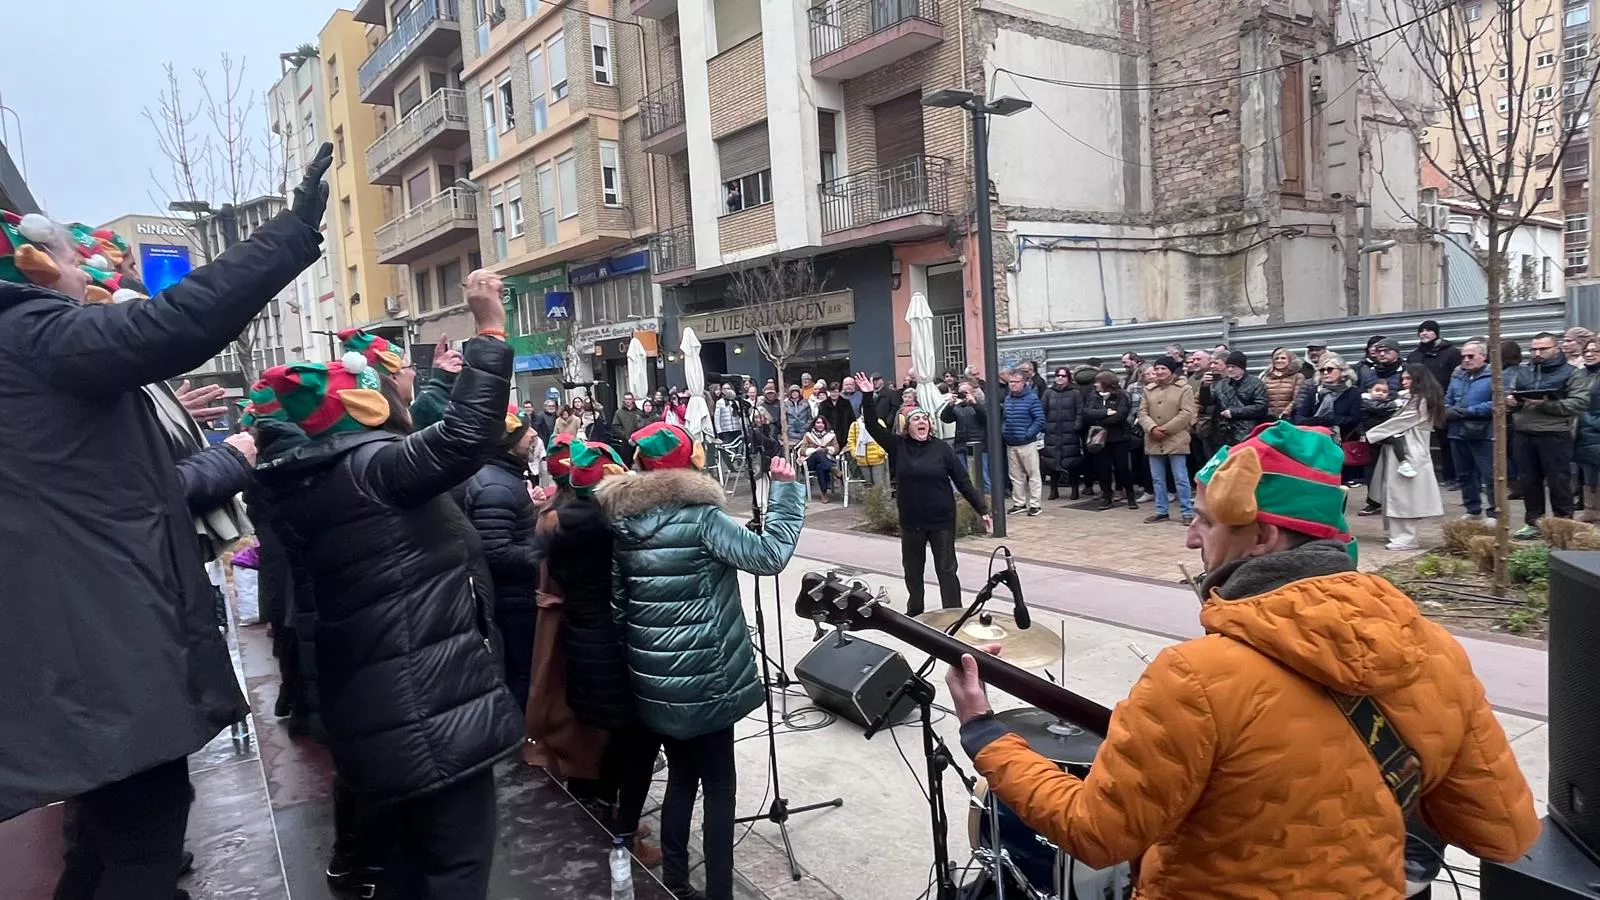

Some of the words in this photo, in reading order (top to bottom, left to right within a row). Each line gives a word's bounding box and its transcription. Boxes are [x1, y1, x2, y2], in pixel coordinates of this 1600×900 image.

[547, 306, 568, 318] AXA
[705, 317, 719, 333] EL
[721, 312, 755, 333] VIEJO
[828, 304, 842, 314] BAR
